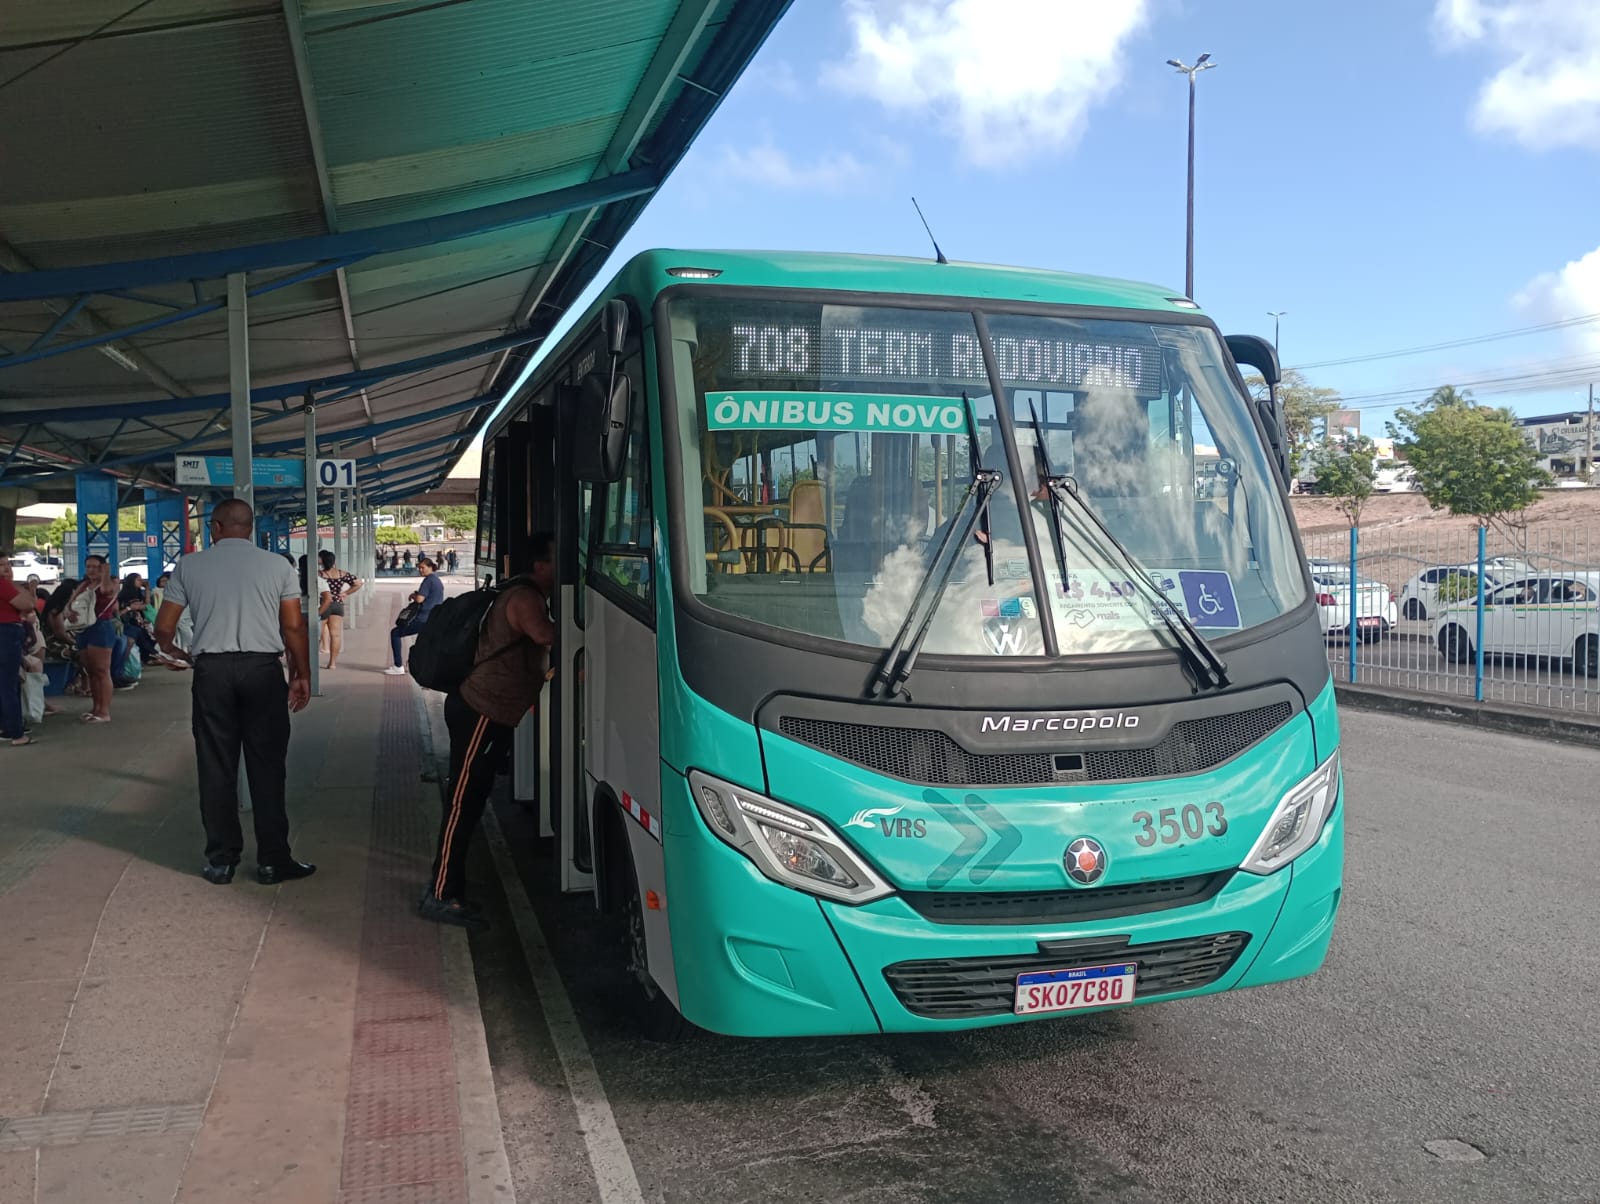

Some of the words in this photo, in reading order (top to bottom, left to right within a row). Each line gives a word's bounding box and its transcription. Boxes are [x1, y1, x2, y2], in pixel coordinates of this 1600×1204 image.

[733, 326, 809, 373] 708
[714, 395, 854, 425] ÔNIBUS
[866, 403, 963, 429] NOVO
[319, 460, 353, 486] 01
[1055, 580, 1084, 601] R$
[1090, 581, 1136, 601] 4,50
[980, 713, 1139, 734] Marcopolo
[880, 817, 927, 838] VRS
[1131, 801, 1229, 848] 3503
[1068, 970, 1087, 978] BRASIL
